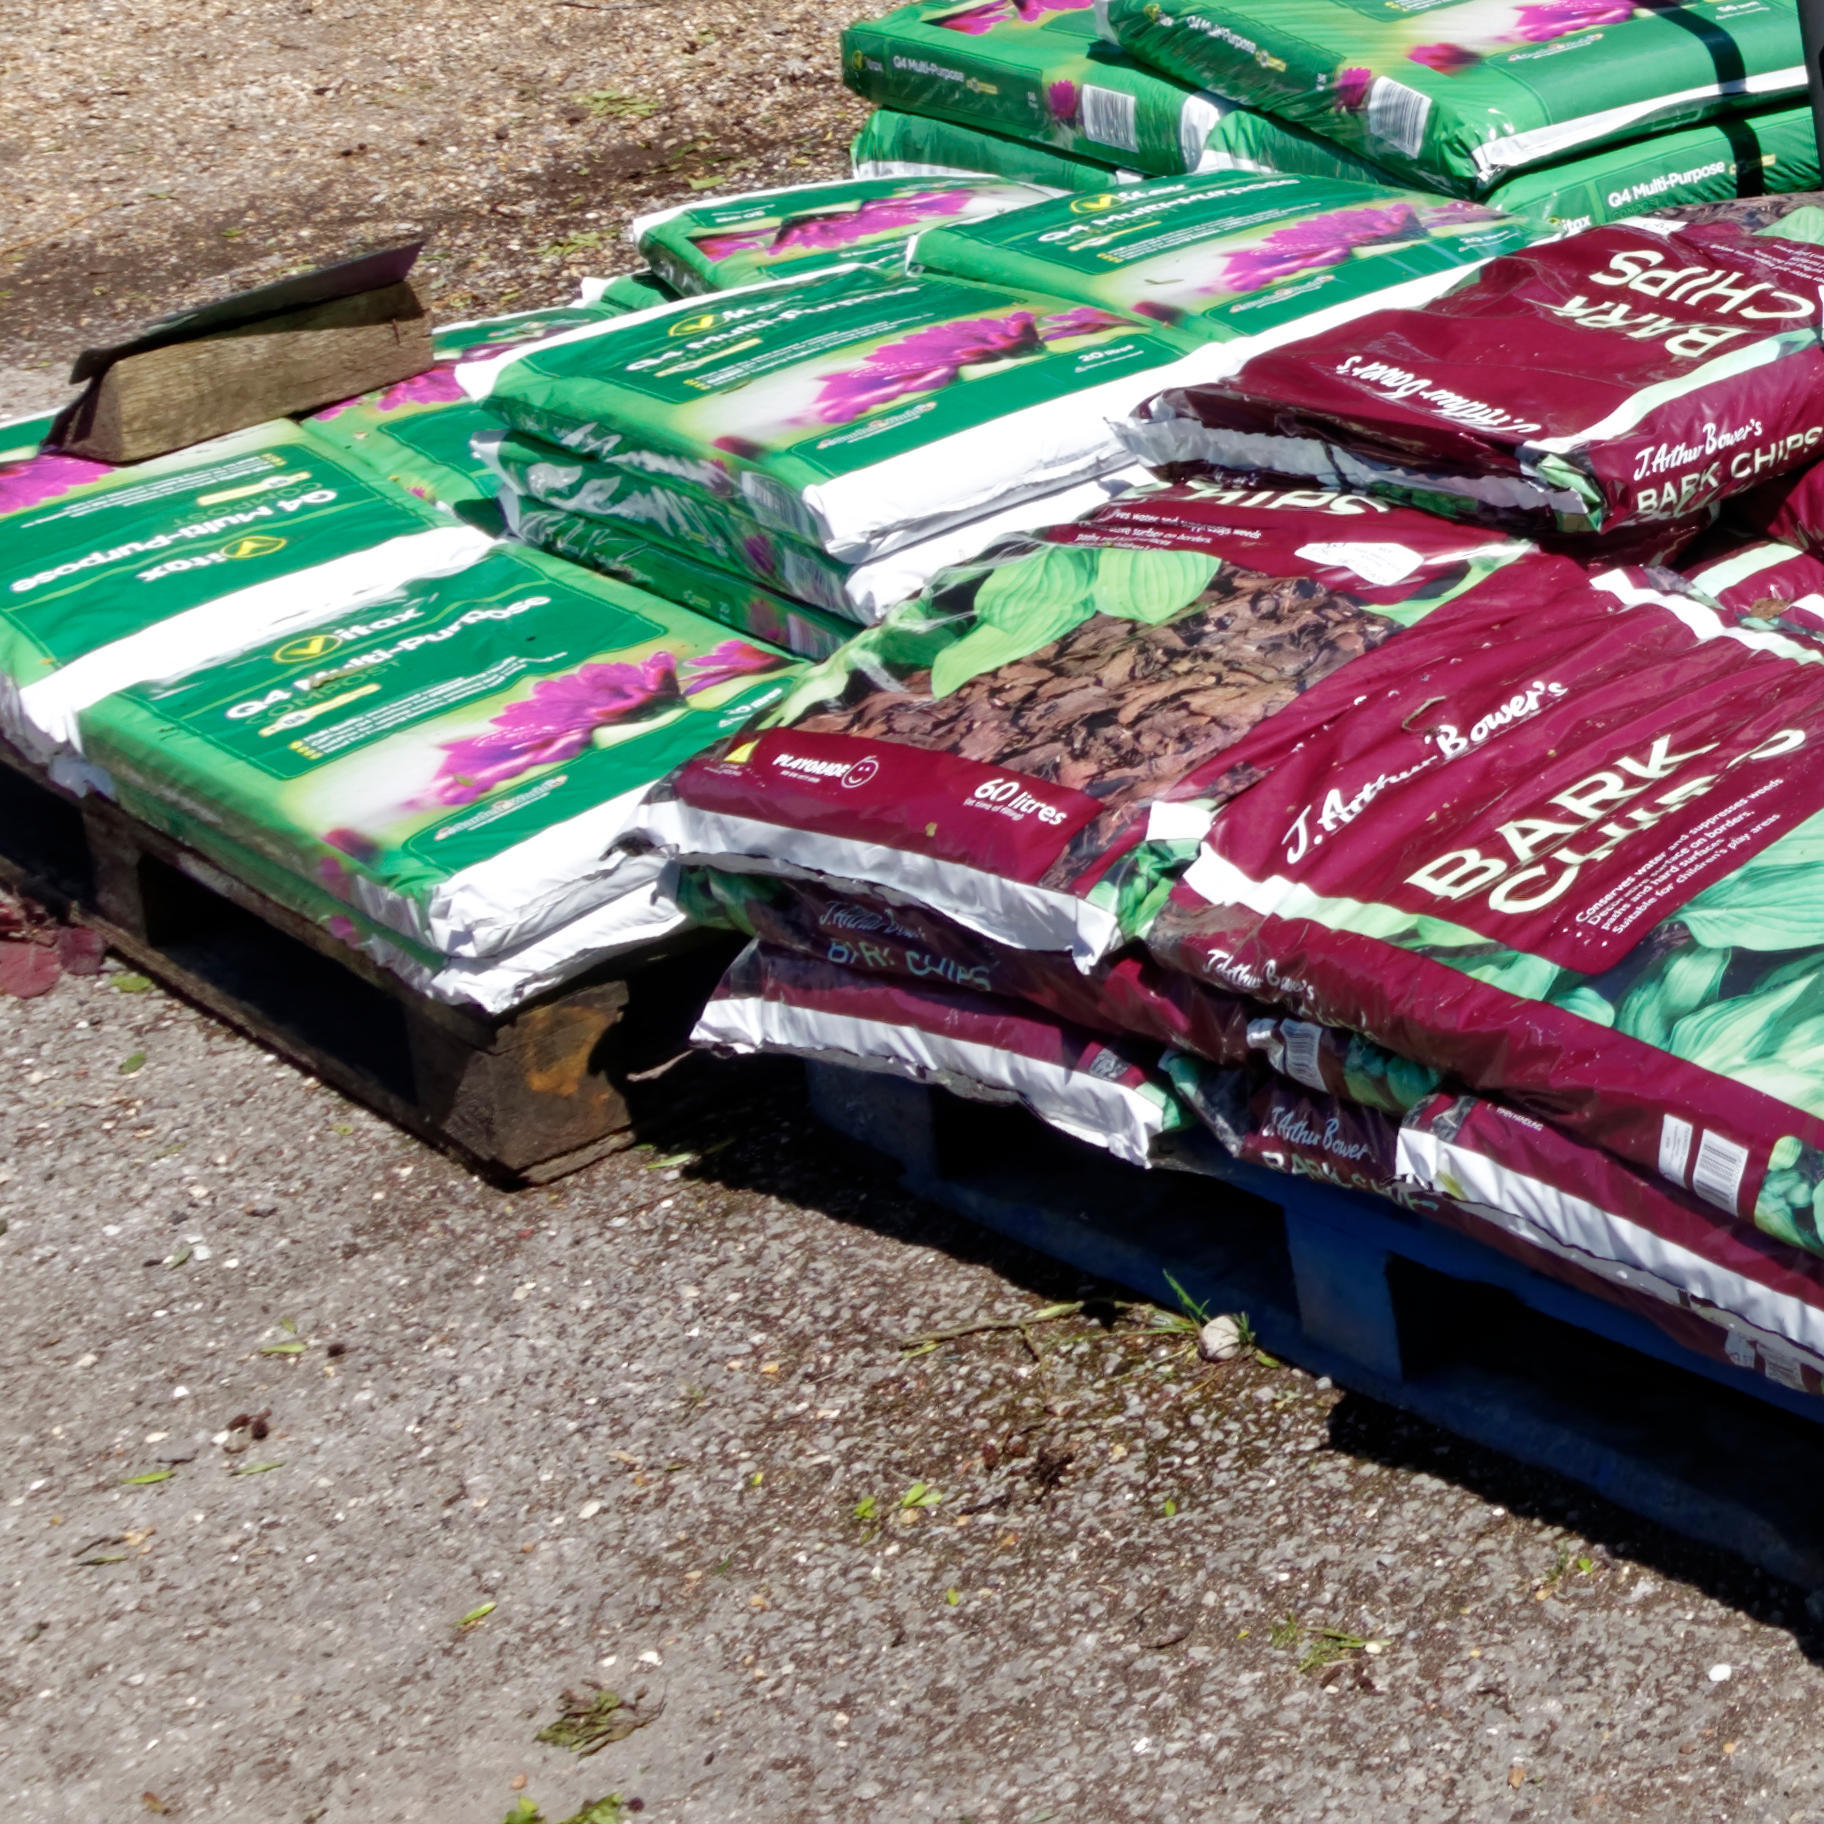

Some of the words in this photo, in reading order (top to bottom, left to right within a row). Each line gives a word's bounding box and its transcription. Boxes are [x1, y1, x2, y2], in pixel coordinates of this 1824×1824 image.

[1608, 193, 1631, 207] Q4
[1633, 162, 1725, 200] Multi-Purpose
[1590, 249, 1816, 320] CHIPS
[1636, 470, 1719, 515] BARK
[1730, 425, 1824, 477] CHIPS
[1702, 418, 1763, 458] Bower's
[227, 689, 291, 719] Q4
[1424, 680, 1569, 754] Bower's
[772, 754, 850, 778] PLAYGRADE
[975, 778, 1019, 802] 60
[1009, 791, 1067, 825] litres
[1404, 733, 1720, 901] BARK
[1576, 877, 1636, 923] Conserves
[1635, 852, 1666, 876] water
[1669, 835, 1689, 851] and
[1689, 799, 1748, 835] suppresses
[1748, 779, 1784, 800] weeds
[1602, 904, 1631, 930] paths
[1631, 886, 1652, 902] and
[1652, 866, 1679, 886] hard
[1680, 839, 1724, 867] surfaces
[1613, 898, 1657, 934] Suitable
[1656, 884, 1673, 896] for
[1676, 849, 1727, 883] children's
[1728, 834, 1750, 849] play
[1750, 815, 1780, 833] areas
